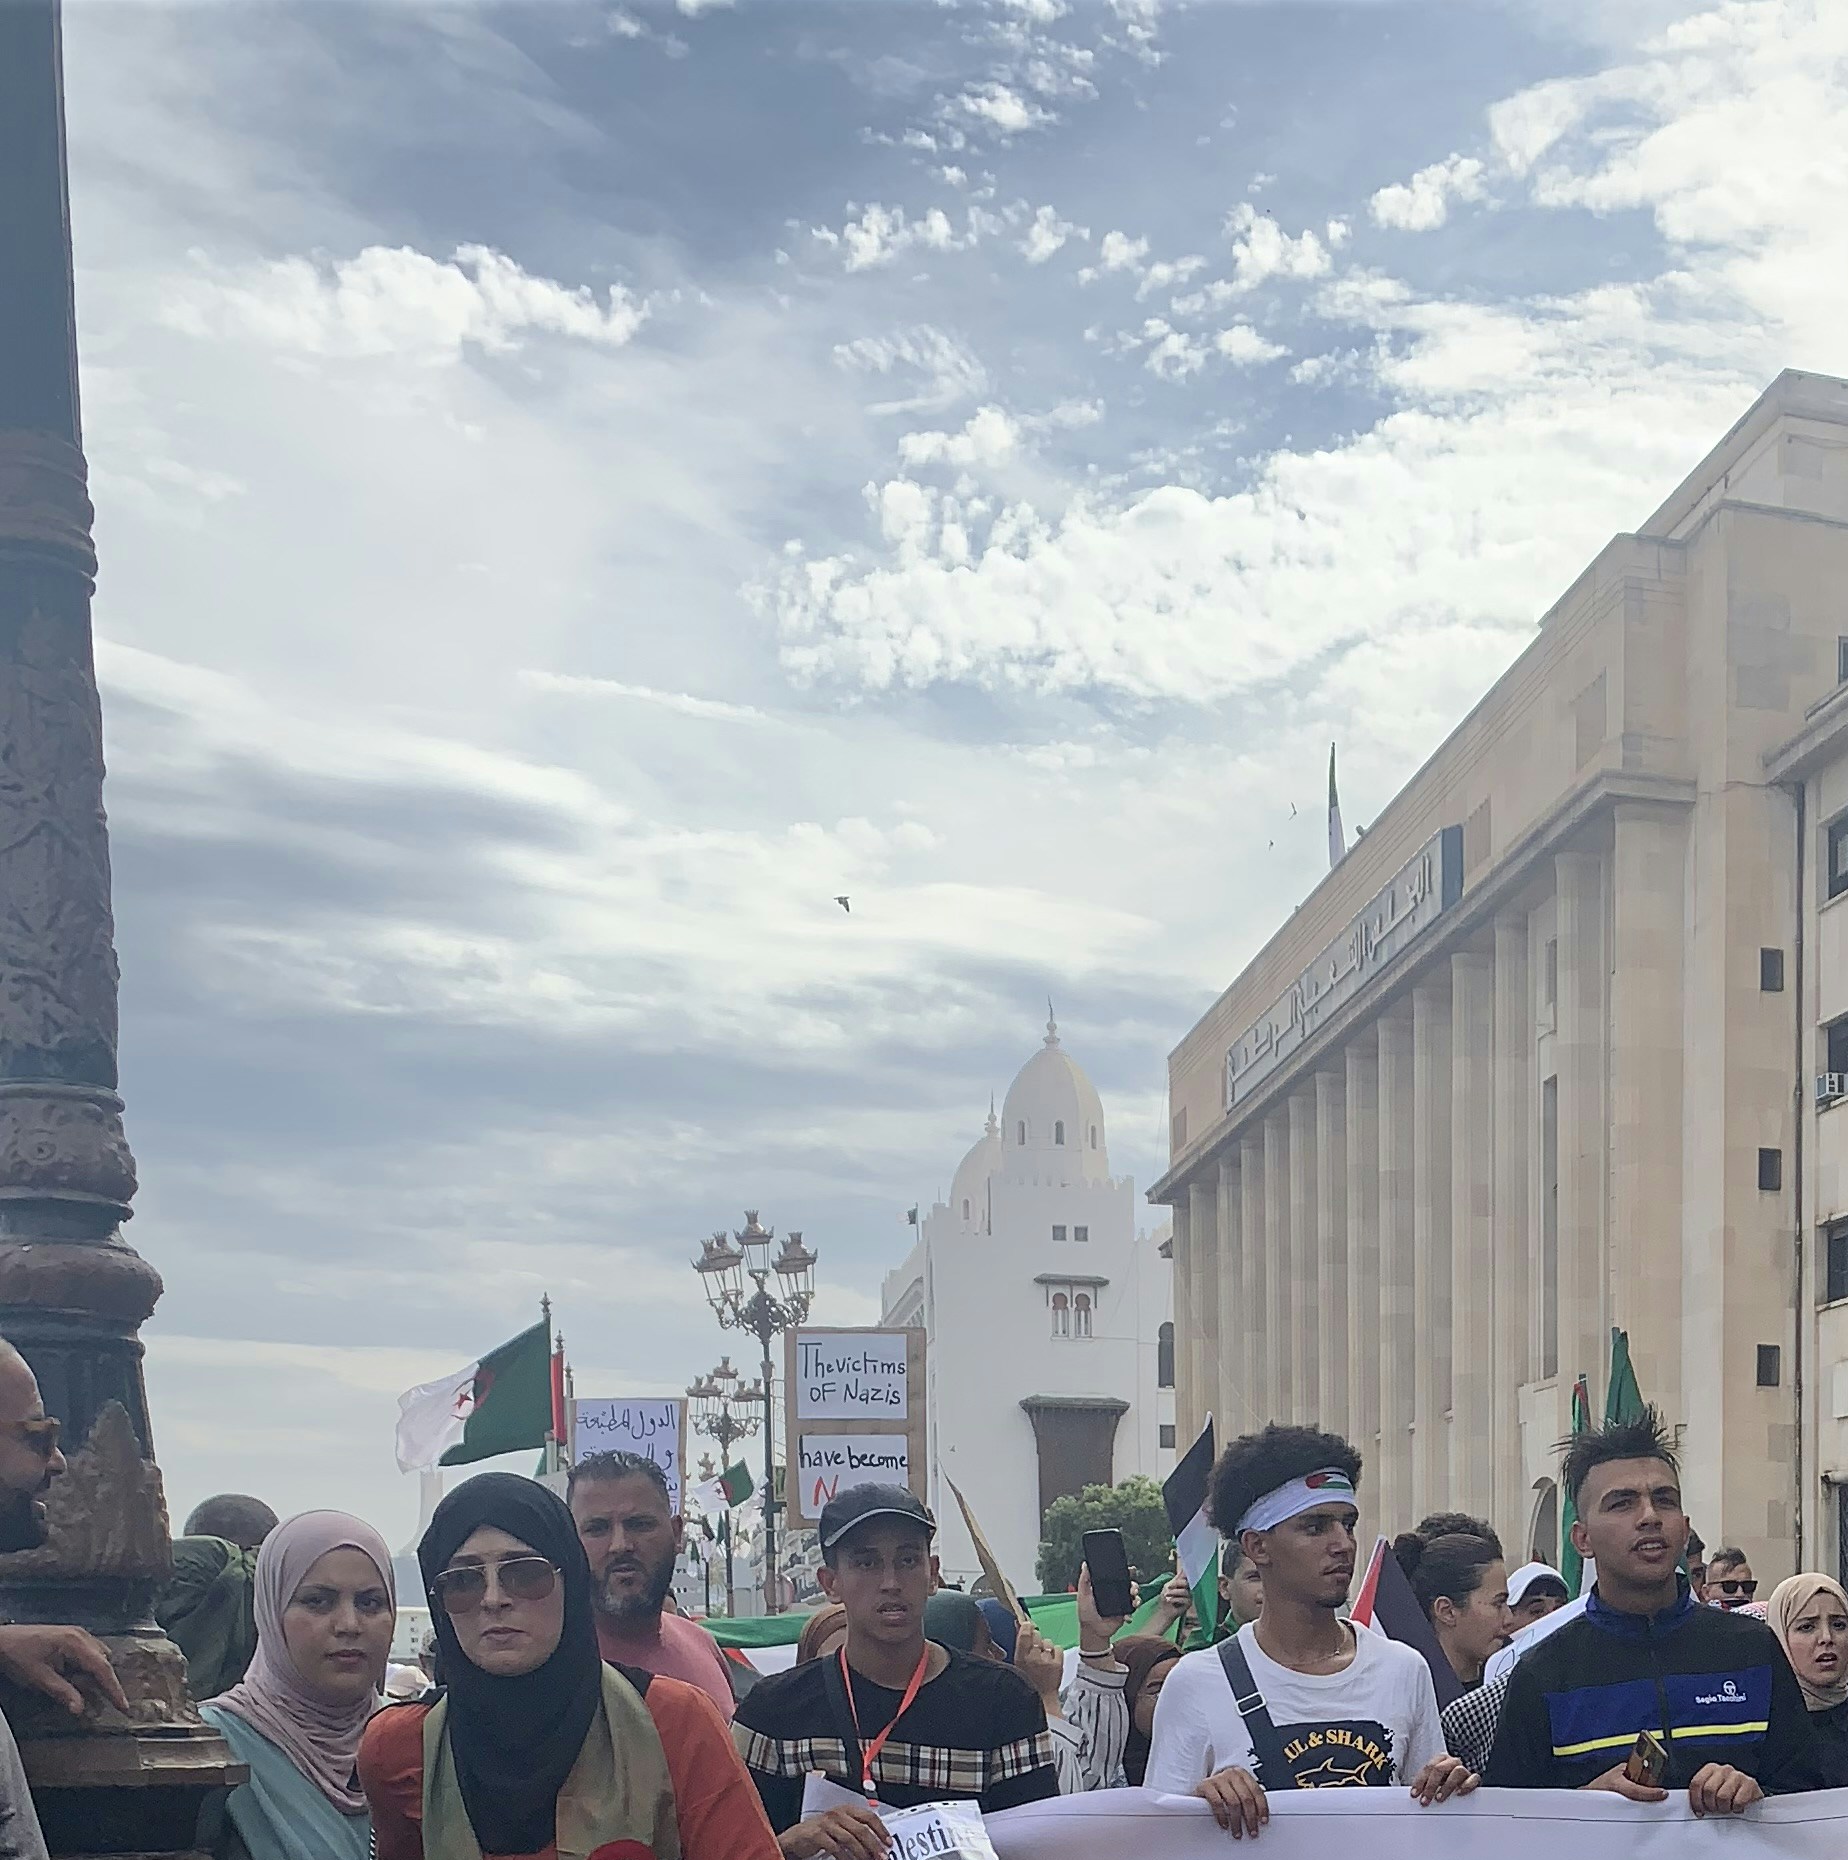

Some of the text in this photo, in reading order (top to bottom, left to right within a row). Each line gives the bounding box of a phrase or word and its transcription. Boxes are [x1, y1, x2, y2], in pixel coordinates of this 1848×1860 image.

[844, 1378, 901, 1405] Nazis
[631, 1404, 675, 1440] الدول
[799, 1435, 909, 1470] have become
[1308, 1731, 1324, 1748] &
[1325, 1729, 1389, 1771] SHARK
